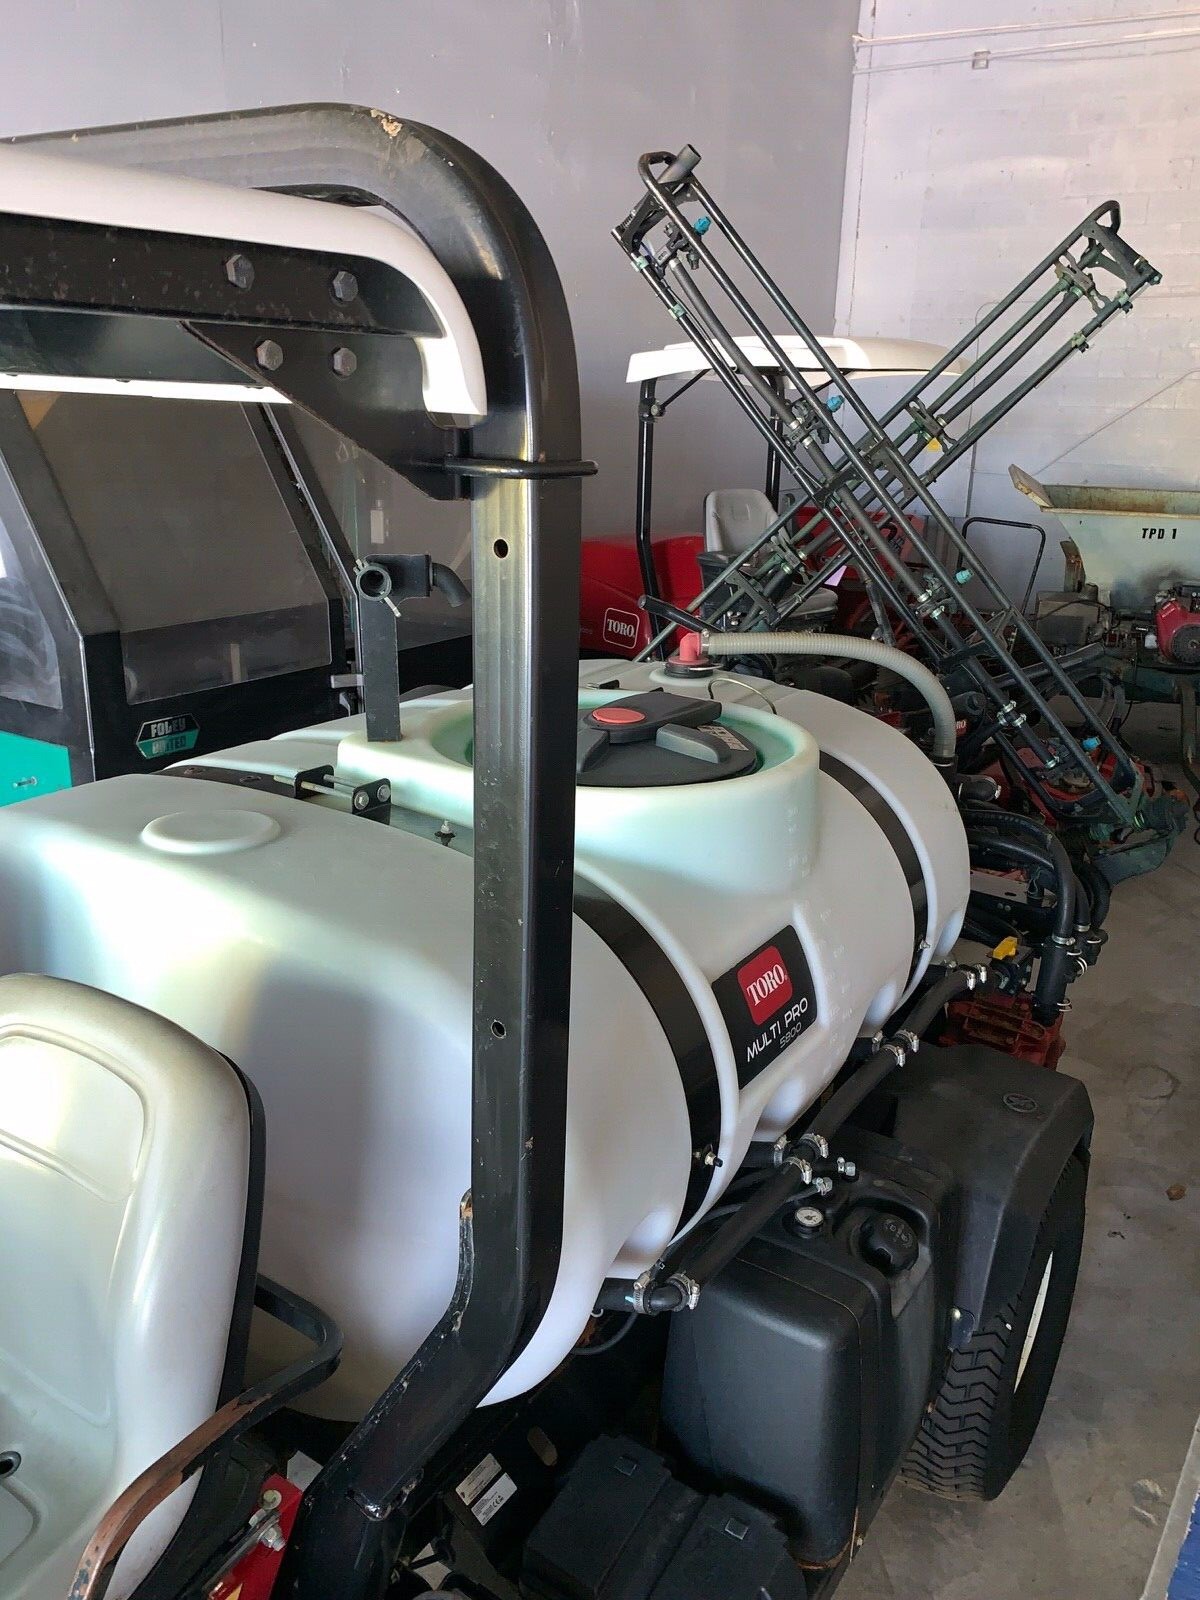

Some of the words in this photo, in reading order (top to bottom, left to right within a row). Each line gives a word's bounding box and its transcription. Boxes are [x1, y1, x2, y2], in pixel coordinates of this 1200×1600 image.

[1141, 527, 1166, 540] TPD
[1171, 527, 1178, 540] 1
[606, 618, 635, 638] TORO
[150, 717, 187, 738] FOLEY
[746, 964, 785, 1006] TORO
[746, 1020, 781, 1063] MULTI
[784, 997, 808, 1028] PRO
[779, 1021, 802, 1049] 5800
